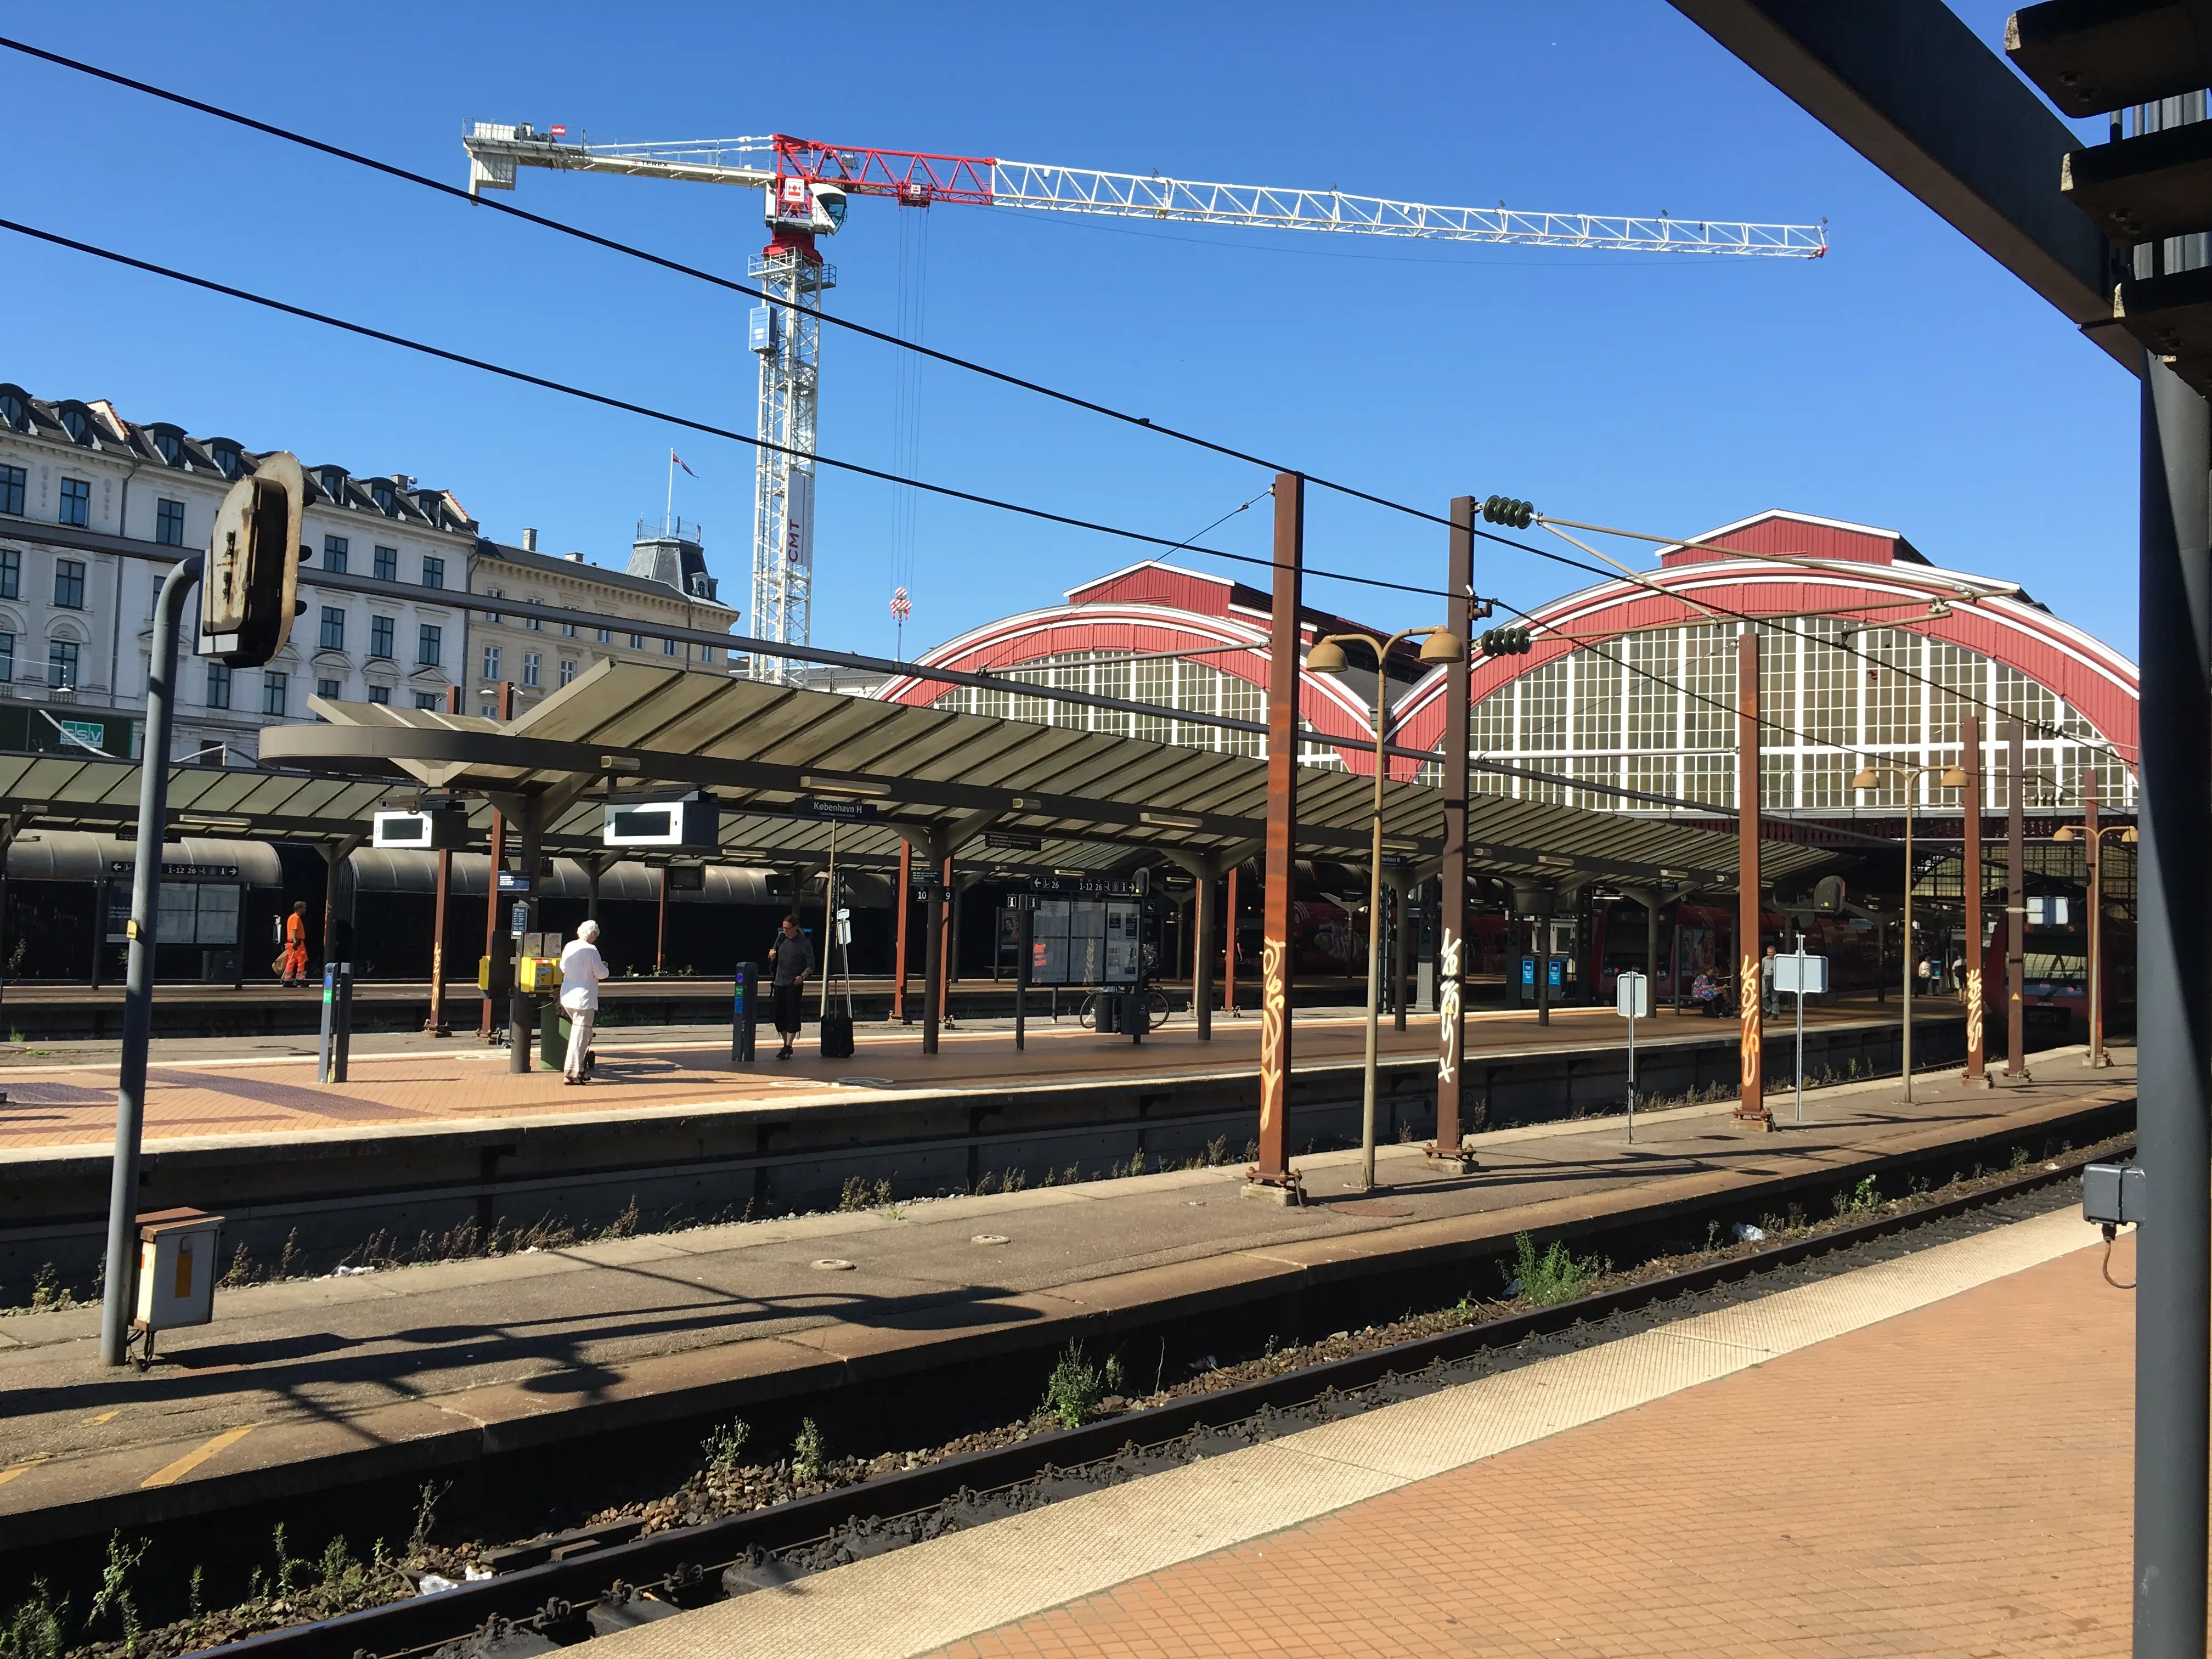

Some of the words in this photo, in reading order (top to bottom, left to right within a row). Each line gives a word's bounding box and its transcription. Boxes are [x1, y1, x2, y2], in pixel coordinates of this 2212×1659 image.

[819, 205, 831, 222] TEREX
[788, 518, 800, 563] CMT
[814, 802, 855, 813] København
[856, 805, 862, 814] H
[1079, 883, 1093, 891] 1-12
[1095, 883, 1103, 891] 26
[918, 891, 927, 900] 10
[945, 891, 951, 900] 9
